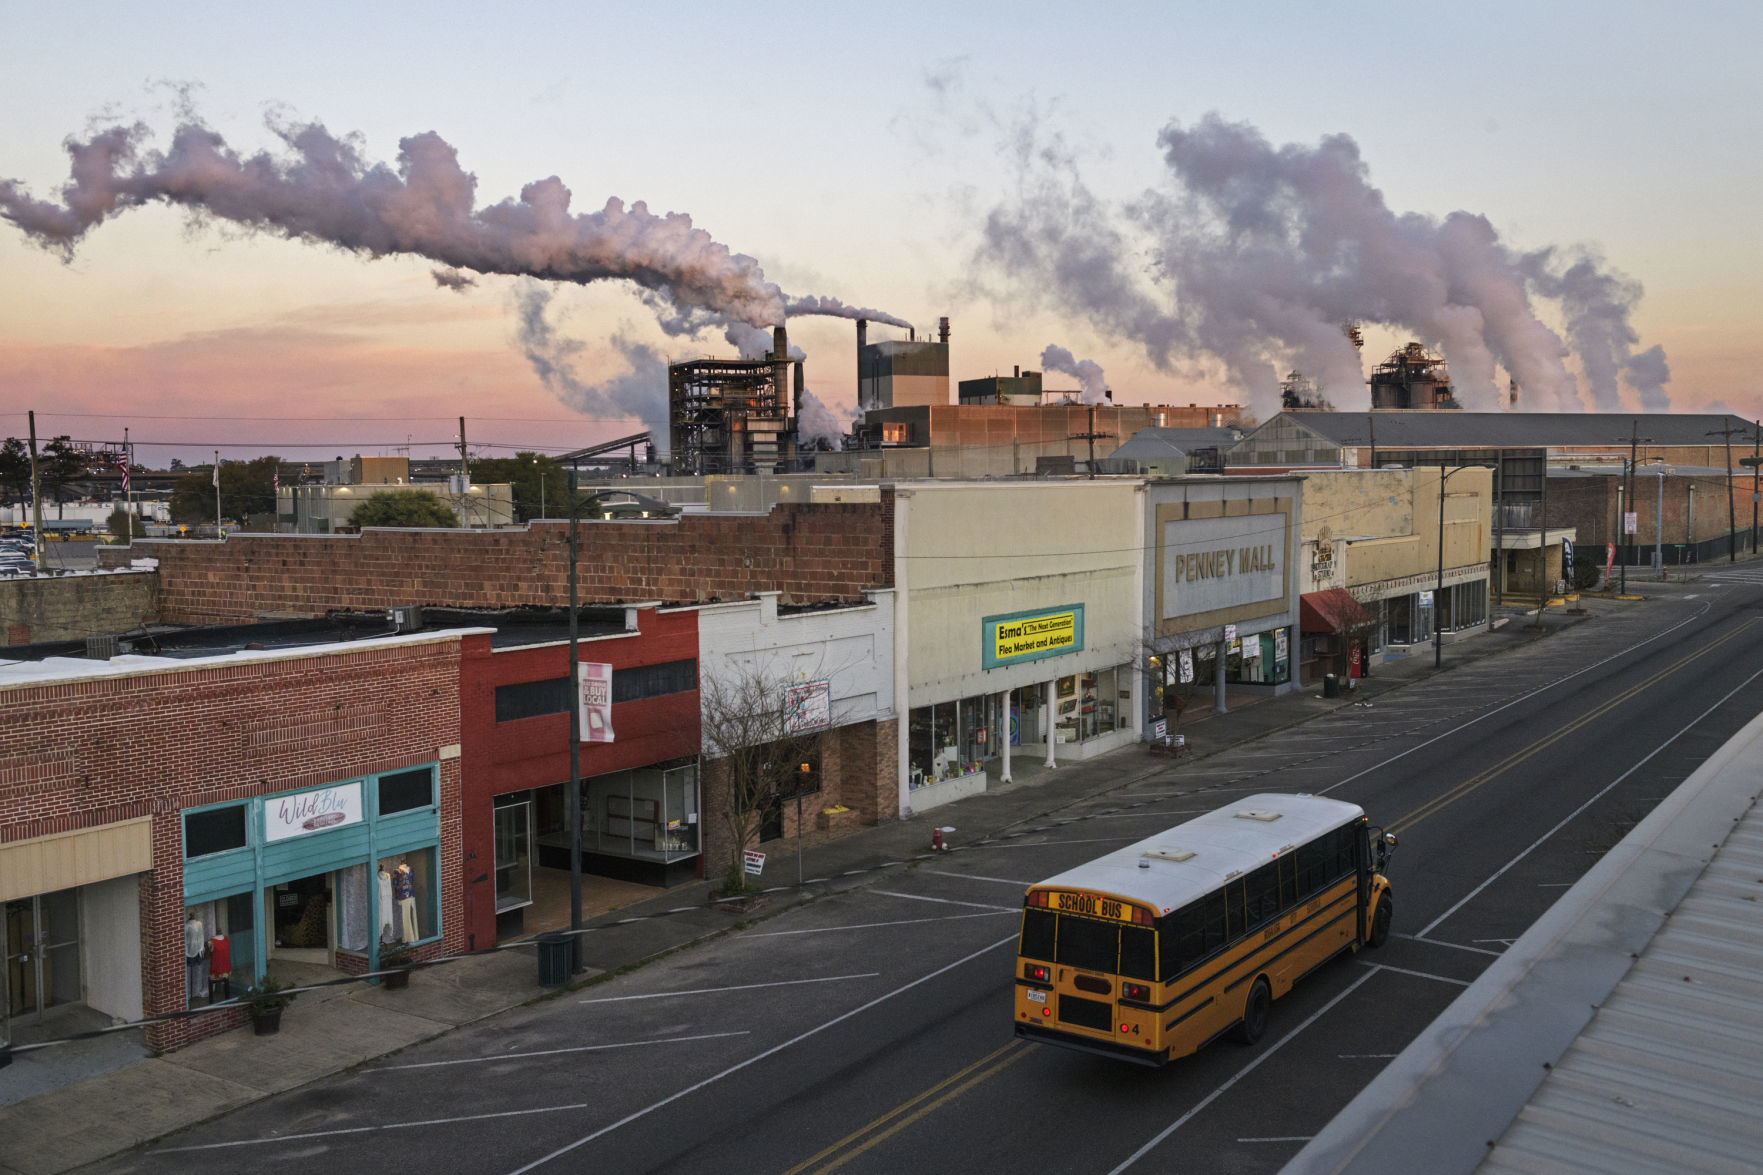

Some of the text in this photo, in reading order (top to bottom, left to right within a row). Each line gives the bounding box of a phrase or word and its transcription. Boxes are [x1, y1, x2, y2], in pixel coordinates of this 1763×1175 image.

[1176, 544, 1276, 583] PENNEY MALL
[999, 623, 1027, 640] Esma's
[1038, 622, 1049, 631] Next
[999, 635, 1073, 655] Flea Market and Antiques
[584, 686, 606, 696] & BUY
[584, 695, 607, 705] LOCAL
[279, 793, 319, 825] Wild
[318, 790, 347, 814] Blu
[1058, 894, 1122, 918] SCHOOL BUS
[1132, 1024, 1140, 1035] 4
